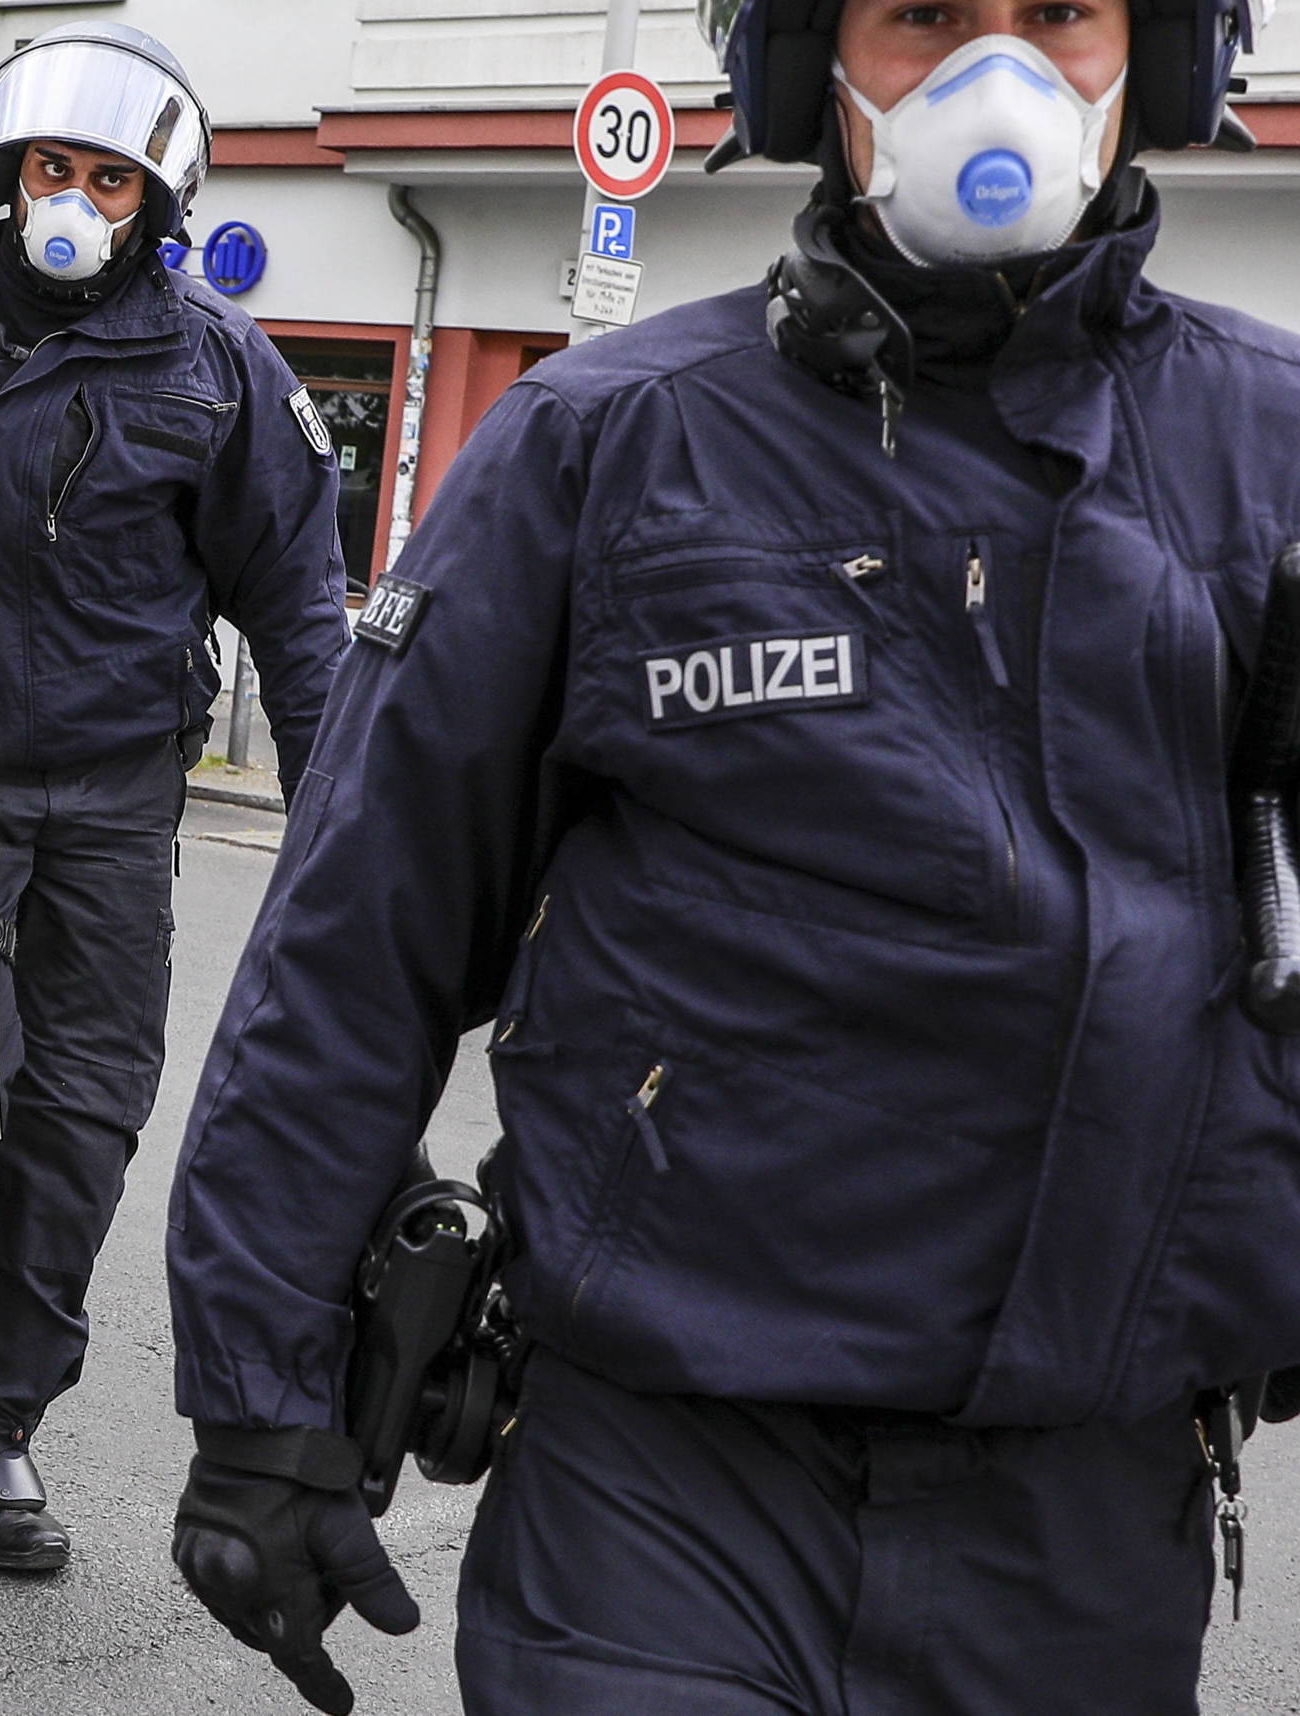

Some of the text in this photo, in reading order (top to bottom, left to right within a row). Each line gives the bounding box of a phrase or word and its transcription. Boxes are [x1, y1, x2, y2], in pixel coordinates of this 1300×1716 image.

[596, 104, 651, 163] 30
[596, 211, 622, 252] P
[361, 587, 414, 635] BFE
[645, 634, 853, 719] POLIZEI
